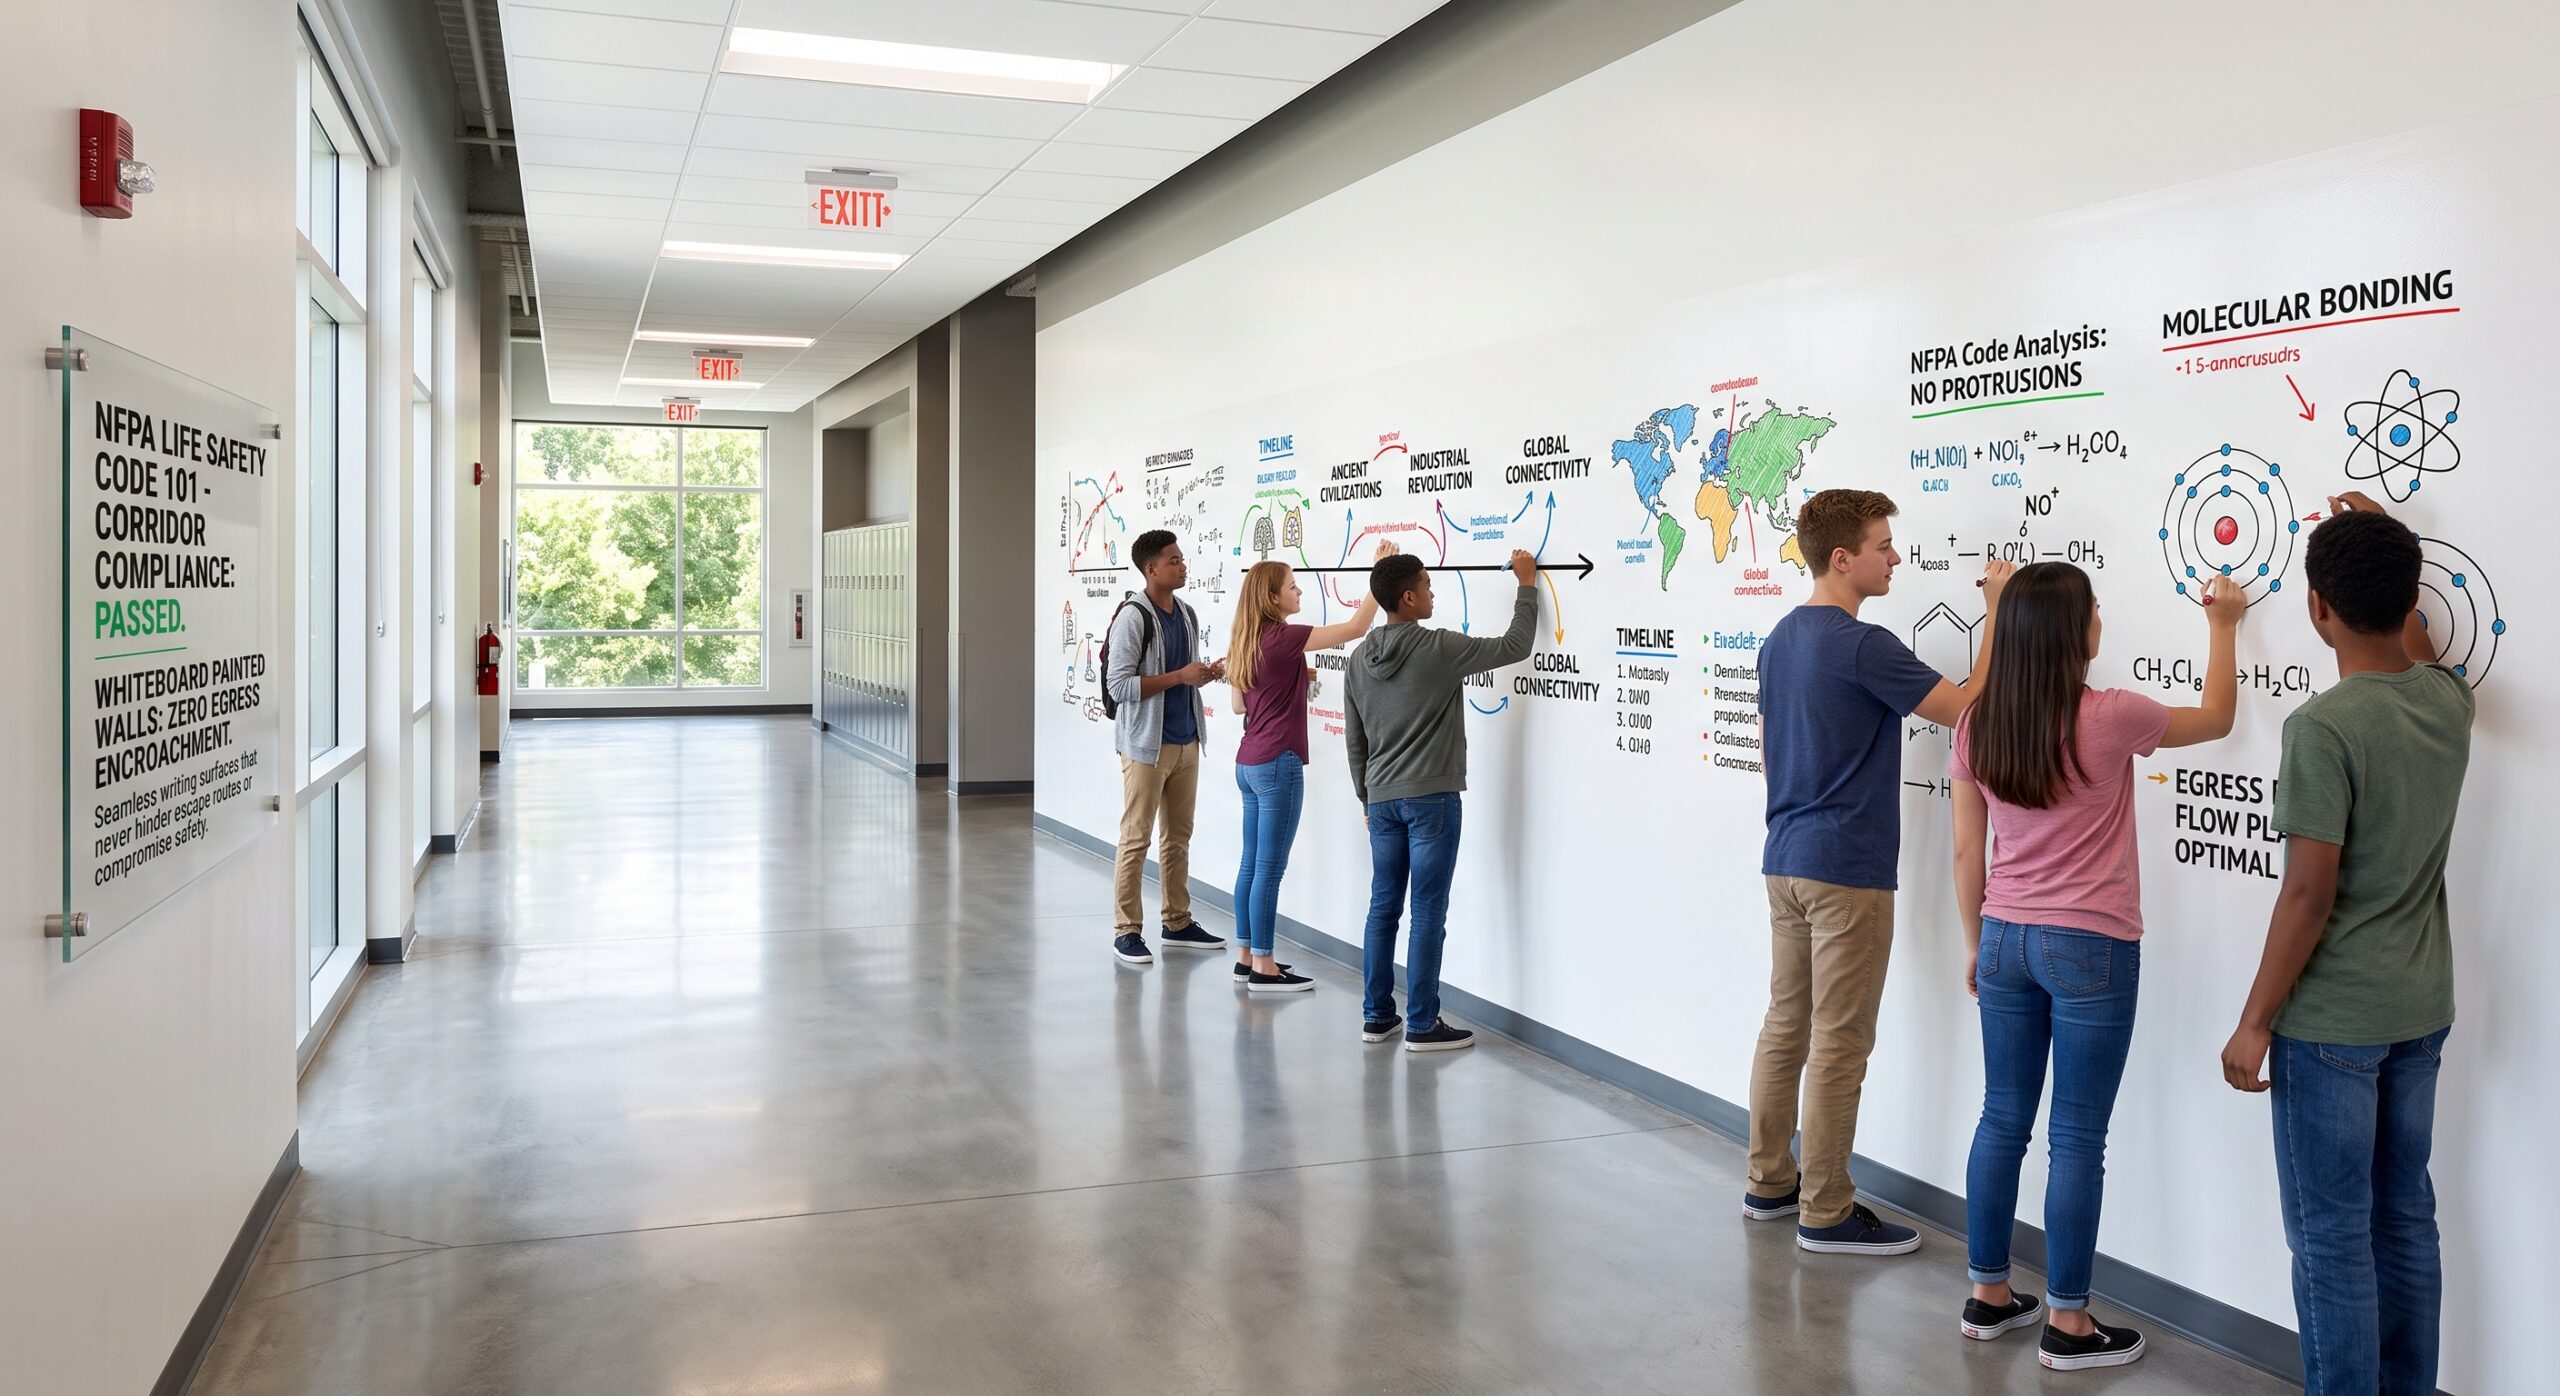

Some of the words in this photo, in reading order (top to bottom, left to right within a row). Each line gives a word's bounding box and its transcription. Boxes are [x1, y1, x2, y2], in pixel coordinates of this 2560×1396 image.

[820, 188, 885, 228] EXITT
[2163, 292, 2311, 339] MOLECULAR
[2320, 269, 2453, 317] BONDING
[1911, 346, 1958, 374] NFPA
[1962, 339, 2008, 364] Code
[2014, 324, 2107, 359] Analysis:
[701, 358, 734, 381] EXIT
[1911, 381, 1936, 406] NO
[1943, 361, 2083, 402] PROTRUSIONS
[668, 404, 695, 422] EXIT
[95, 400, 156, 452] NFPA
[162, 419, 202, 462] LIFE
[206, 433, 267, 477] SAFETY
[1523, 435, 1570, 458] GLOBAL
[95, 451, 158, 498] CODE
[164, 466, 197, 503] 101
[1331, 461, 1369, 481] ANCIENT
[1410, 448, 1470, 472] INDUSTRIAL
[1506, 457, 1591, 484] CONNECTIVITY
[1320, 481, 1382, 503] CIVILIZATIONS
[1408, 471, 1473, 494] REVOLUTION
[95, 501, 206, 547] CORRIDOR
[95, 551, 235, 590] COMPLIANCE:
[95, 599, 186, 640] PASSED.
[1616, 628, 1674, 649] TIMELINE
[95, 662, 208, 710] WHITEBOARD
[212, 653, 266, 686] PAINTED
[1534, 652, 1580, 674] GLOBAL
[1513, 676, 1600, 702] CONNECTIVITY
[1617, 687, 1626, 703] 2.
[95, 706, 164, 750] WALLS:
[167, 695, 207, 731] ZERO
[211, 683, 260, 718] EGRESS
[1617, 711, 1626, 727] 3.
[95, 720, 233, 790] ENCROACHMENT.
[94, 788, 157, 829] Seamless
[160, 772, 197, 803] writing
[199, 760, 239, 787] surfaces
[240, 749, 258, 772] that
[2176, 768, 2264, 804] EGRESS
[95, 826, 132, 858] never
[135, 808, 172, 840] hinder
[174, 795, 211, 823] escape
[212, 782, 241, 808] routes
[243, 775, 252, 791] or
[2176, 803, 2239, 837] FLOW
[95, 835, 172, 886] compromise
[174, 817, 208, 847] safety.
[2175, 838, 2278, 880] OPTIMAL
